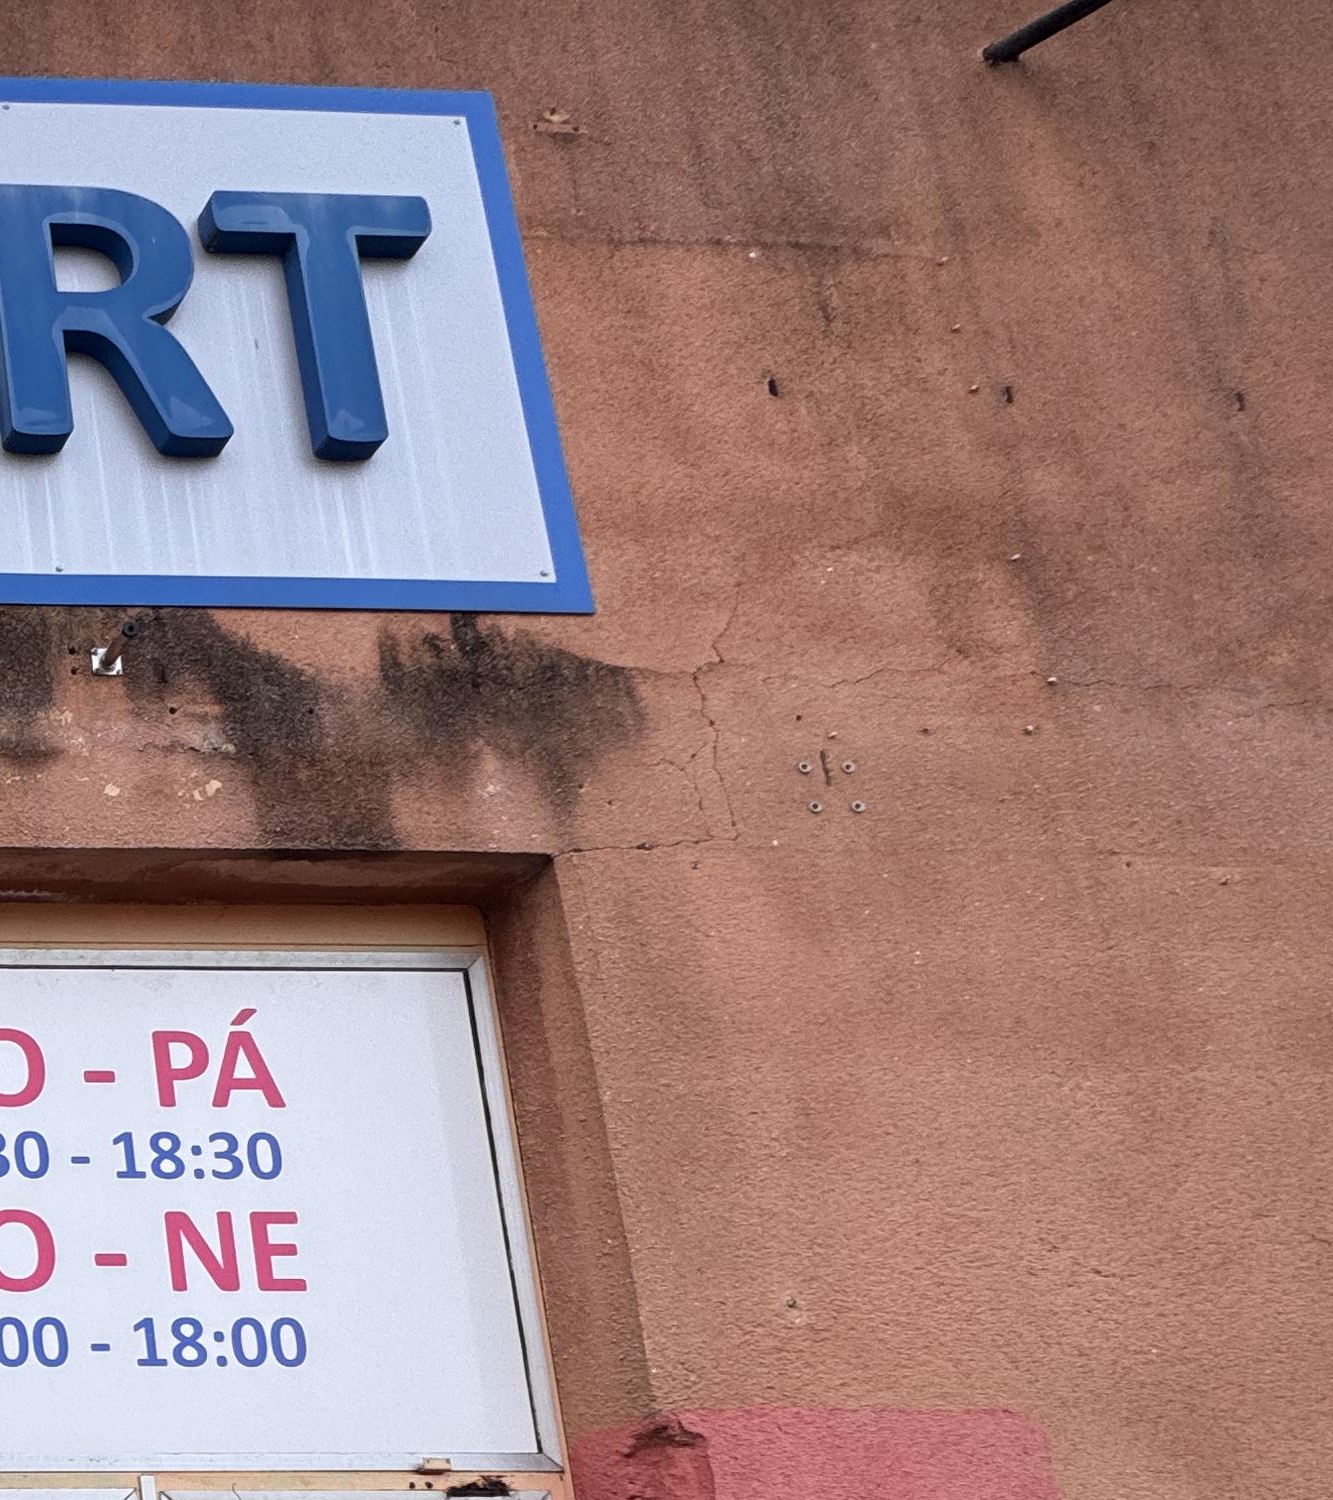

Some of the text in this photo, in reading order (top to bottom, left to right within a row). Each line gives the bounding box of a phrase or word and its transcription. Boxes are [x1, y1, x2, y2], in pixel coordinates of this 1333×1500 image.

[83, 1070, 116, 1083] -
[151, 1008, 287, 1109] PÁ
[70, 1155, 91, 1165] -
[112, 1131, 283, 1180] 18:30
[94, 1252, 128, 1267] -
[164, 1210, 308, 1292] NE
[91, 1342, 111, 1353] -
[132, 1316, 308, 1367] 18:00
